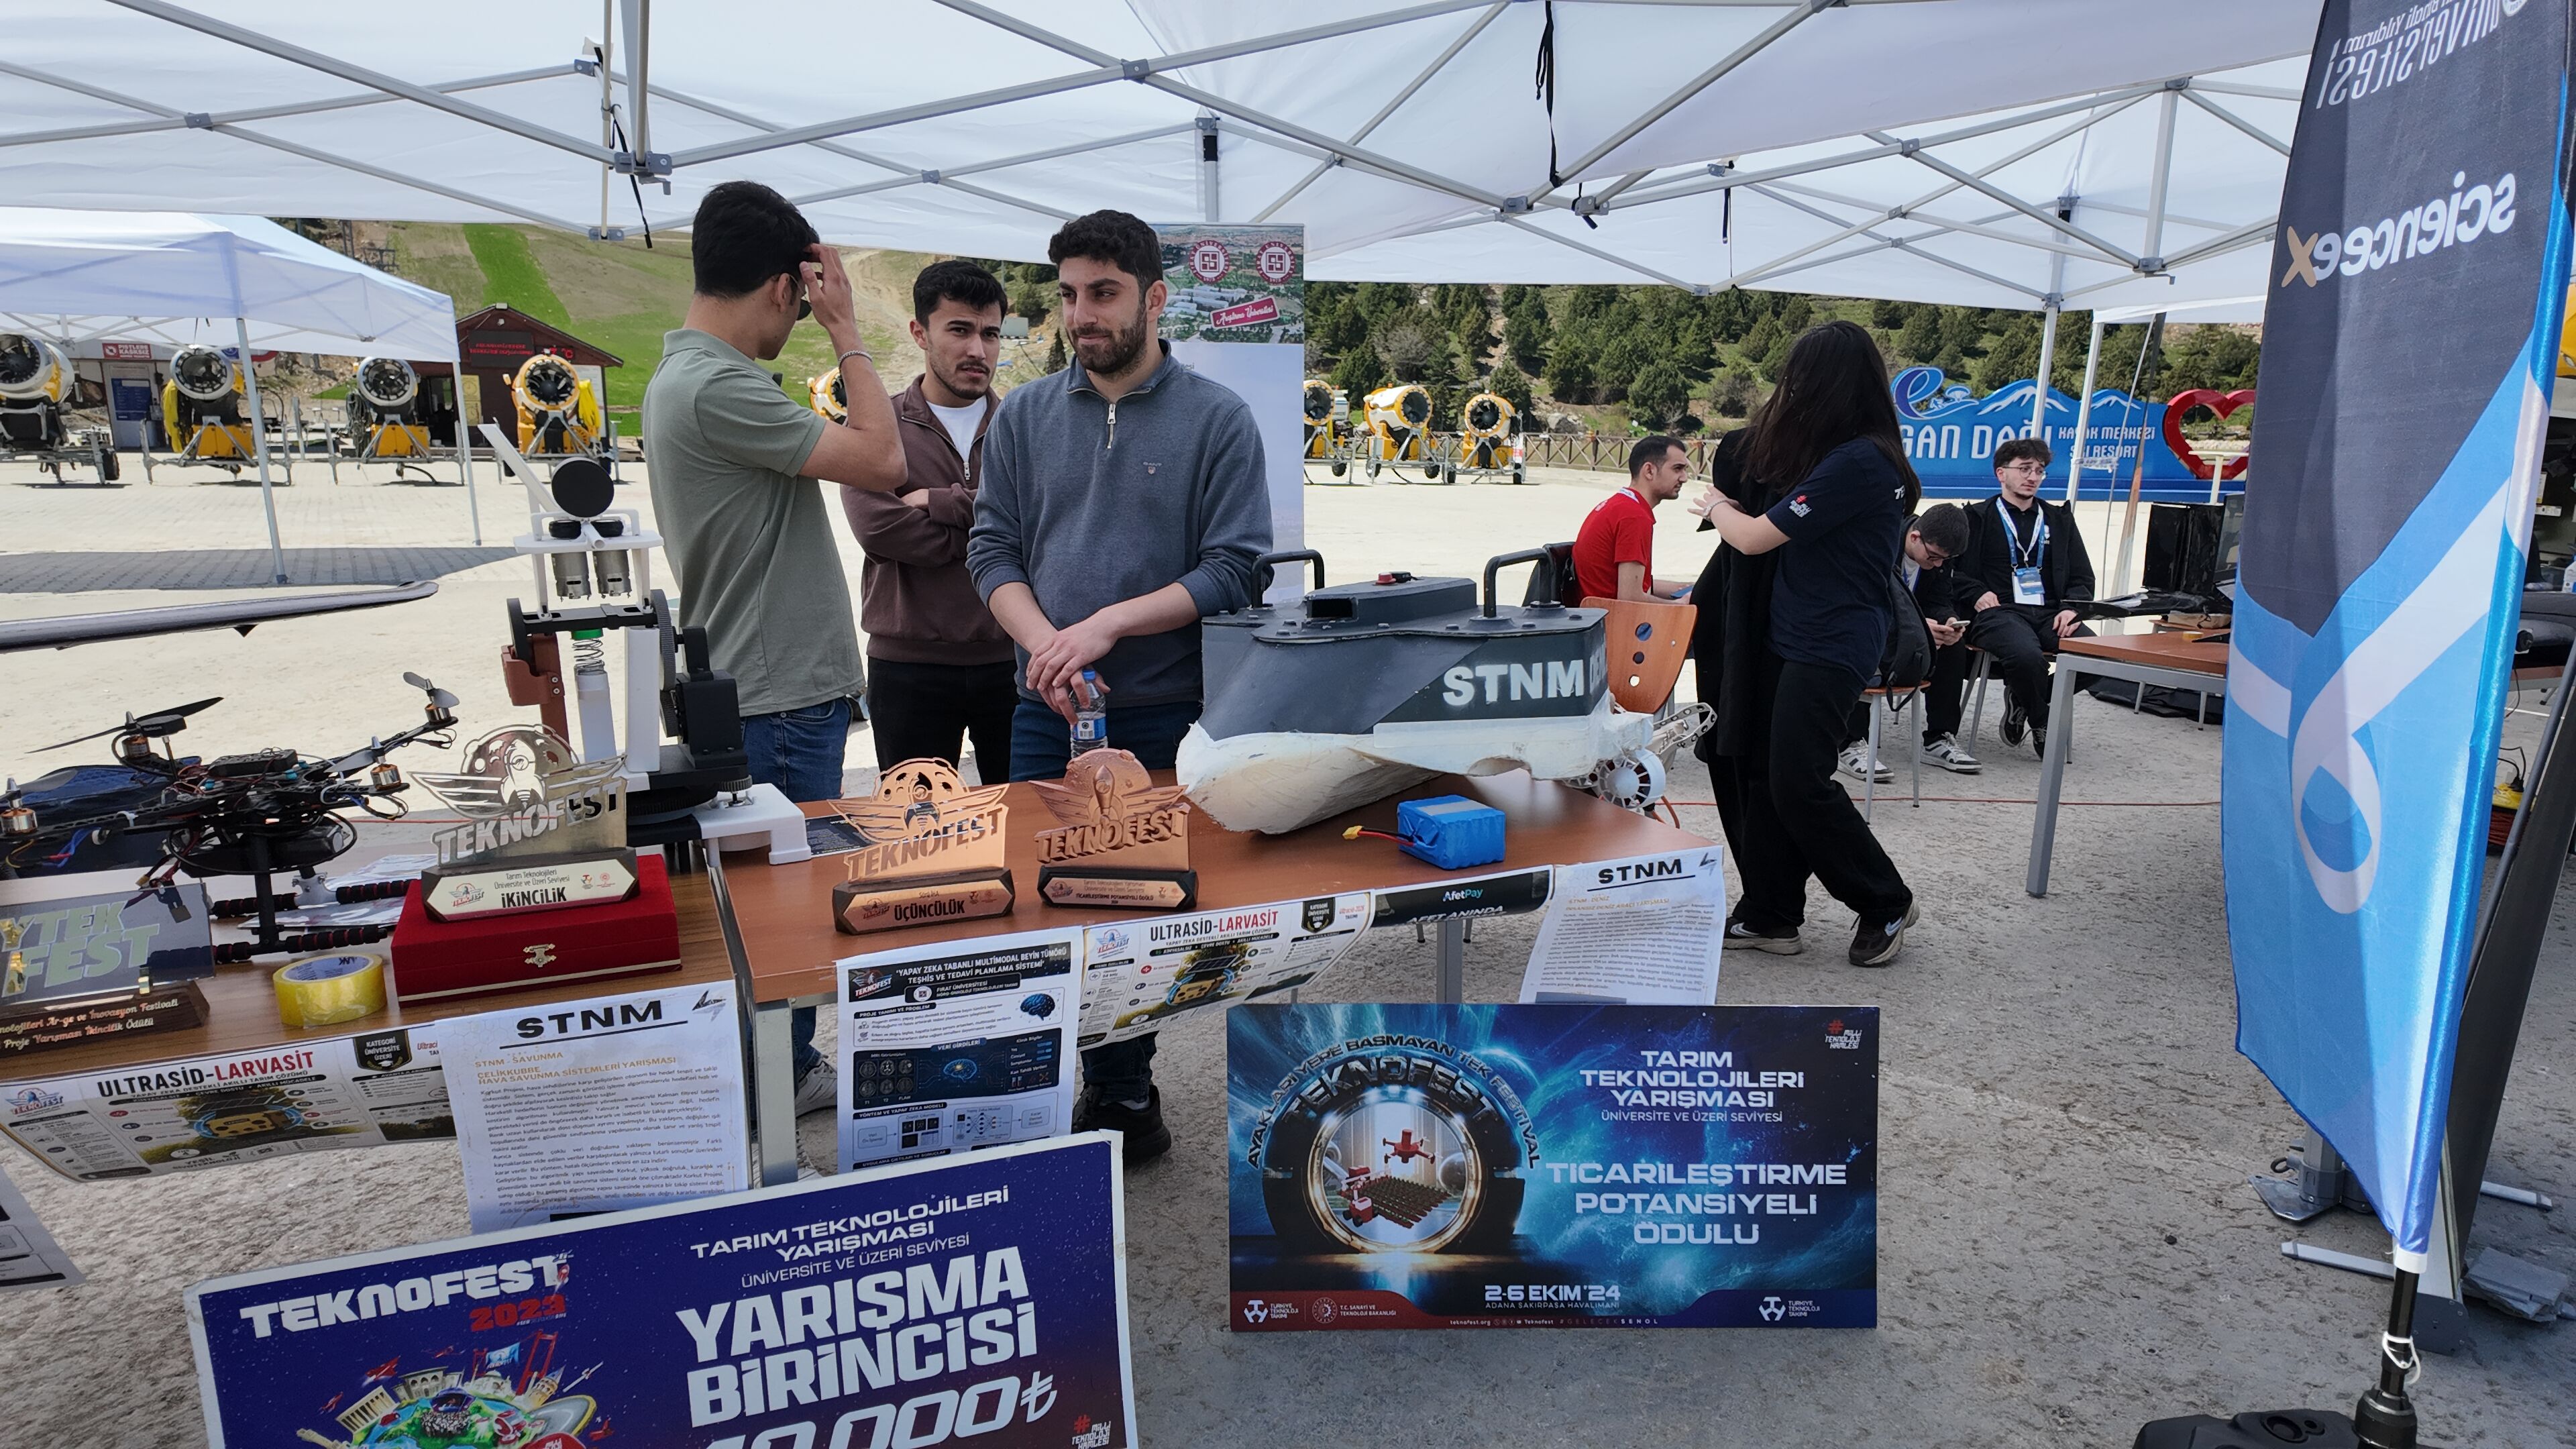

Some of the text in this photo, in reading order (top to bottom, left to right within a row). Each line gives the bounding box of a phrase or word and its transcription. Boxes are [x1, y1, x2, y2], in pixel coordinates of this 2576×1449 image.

[1442, 659, 1585, 706] STNM
[433, 778, 624, 865] TEKNOFEST
[1033, 804, 1191, 865] TEKNOFEST
[847, 806, 1006, 881] TEKNOFEST
[523, 869, 557, 879] Teknolojileri
[1598, 858, 1682, 884] STNM
[1442, 889, 1483, 902] AfetPay
[894, 899, 965, 922] ÜÇÜNCÜLÜK
[1, 923, 160, 998] FEST
[908, 973, 934, 985] TEŞHİS
[936, 971, 945, 981] VE
[947, 967, 973, 979] TEDAVİ
[975, 963, 1014, 975] PLANLAMA
[923, 963, 943, 974] ZEKA
[944, 960, 973, 971] TABANLI
[975, 953, 1020, 967] MULTİMODAL
[1020, 950, 1039, 961] BEYİN
[1040, 946, 1067, 959] TÜMÖRÜ
[855, 977, 892, 997] TEKNOFEST
[76, 1014, 86, 1022] ve
[517, 1000, 663, 1039] STNM
[4, 1038, 30, 1051] Proje
[1294, 1043, 1344, 1076] YERE
[1345, 1035, 1456, 1059] BASMAYAN
[1458, 1051, 1494, 1079] TEK
[475, 1058, 504, 1068] STNM
[513, 1052, 564, 1064] SAVUNMA
[479, 1057, 677, 1085] HAVA SAVUNMA SİSTEMLERİ YARIŞMASI
[1640, 1051, 1733, 1068] TARIM
[1281, 1055, 1501, 1123] TEKNOFEST
[1610, 1089, 1774, 1109] YARIŞMASI
[1601, 1109, 1782, 1123] ÜNİVERSİTE VE ÜZERİ SEVİYESİ
[690, 1185, 1009, 1259] TARIM TEKNOLOJİLERİ
[776, 1220, 934, 1263] YARIŞMASI
[741, 1232, 970, 1289] ÜNİVERSİTE VE ÜZERİ SEVİYESİ
[239, 1255, 570, 1338] TEKNOFEST
[676, 1246, 1030, 1363] YARIŞMA
[1485, 1285, 1525, 1301] 2-6
[470, 1293, 566, 1332] 2023
